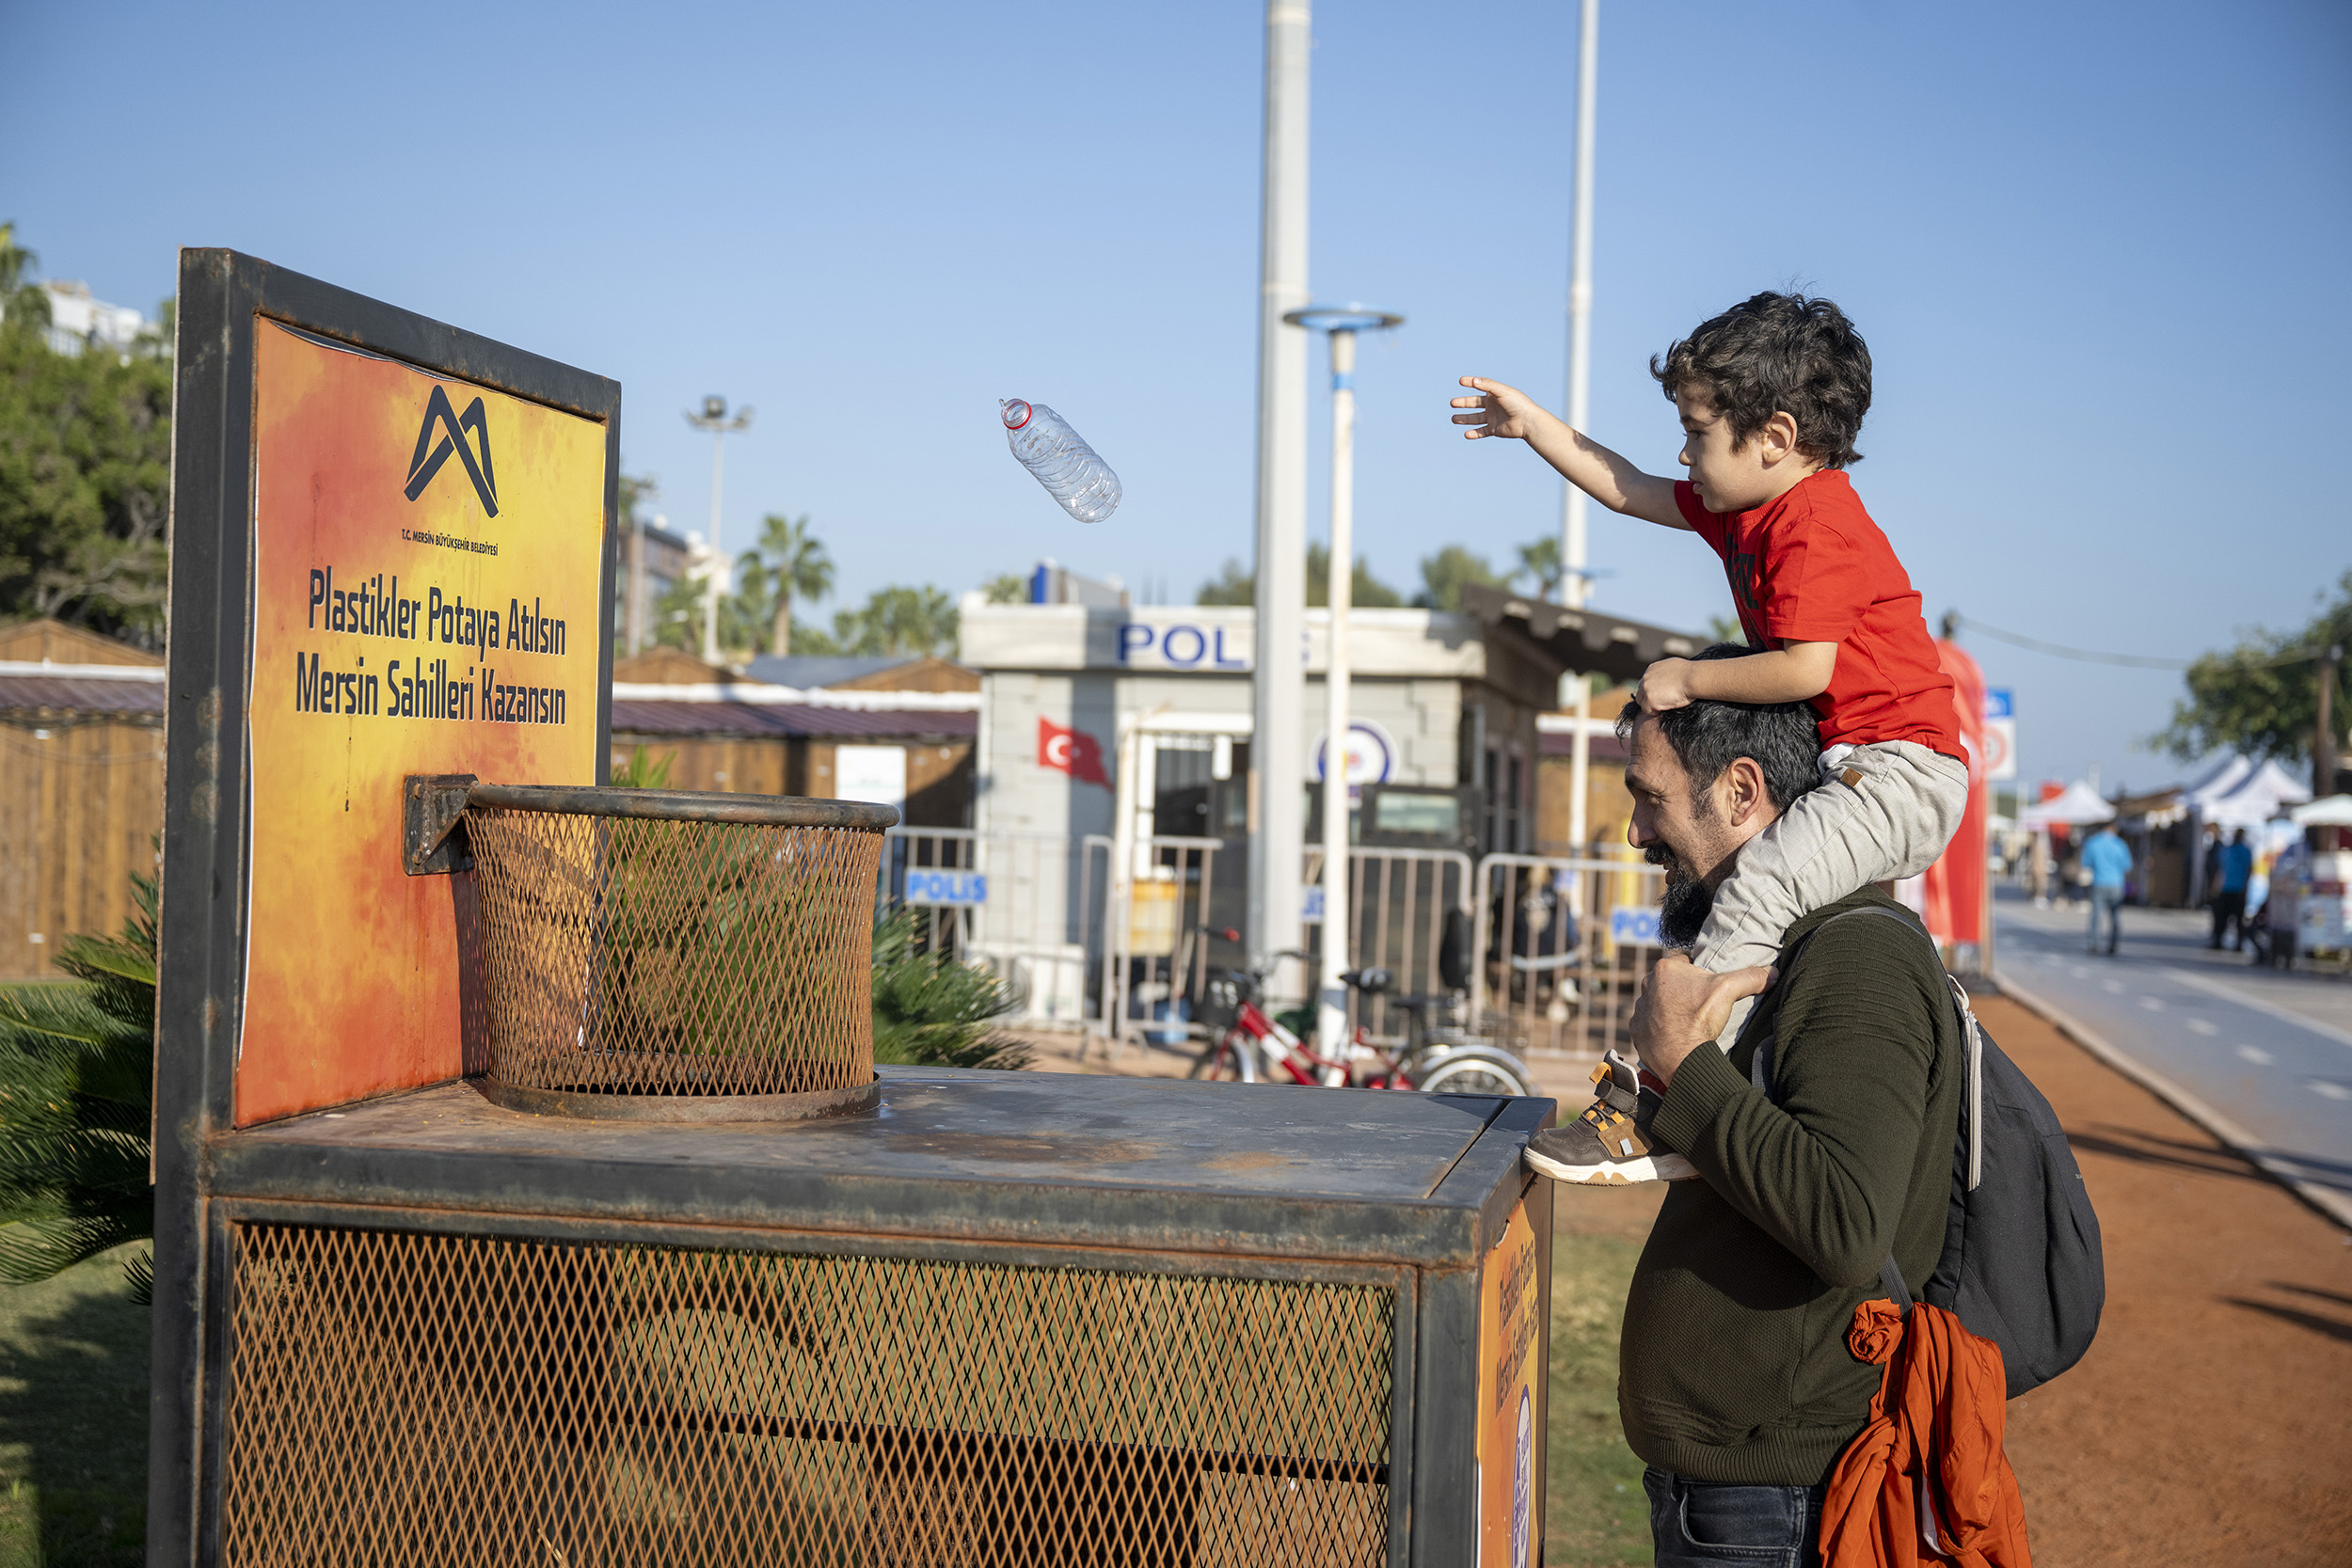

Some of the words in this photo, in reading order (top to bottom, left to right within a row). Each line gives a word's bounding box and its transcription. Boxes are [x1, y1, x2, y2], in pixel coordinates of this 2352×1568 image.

[401, 528, 411, 541] T.C.
[412, 530, 435, 545] MERSİN
[436, 532, 470, 552] BÜYÜKŞEHİR
[470, 541, 499, 556] BELEDİYESİ
[309, 564, 421, 641] Plastikler
[428, 586, 500, 663] Potaya
[506, 596, 565, 656] Atılsın
[296, 650, 379, 716] Mersin
[387, 657, 474, 721] Sahilleri
[481, 667, 565, 725] Kazansın
